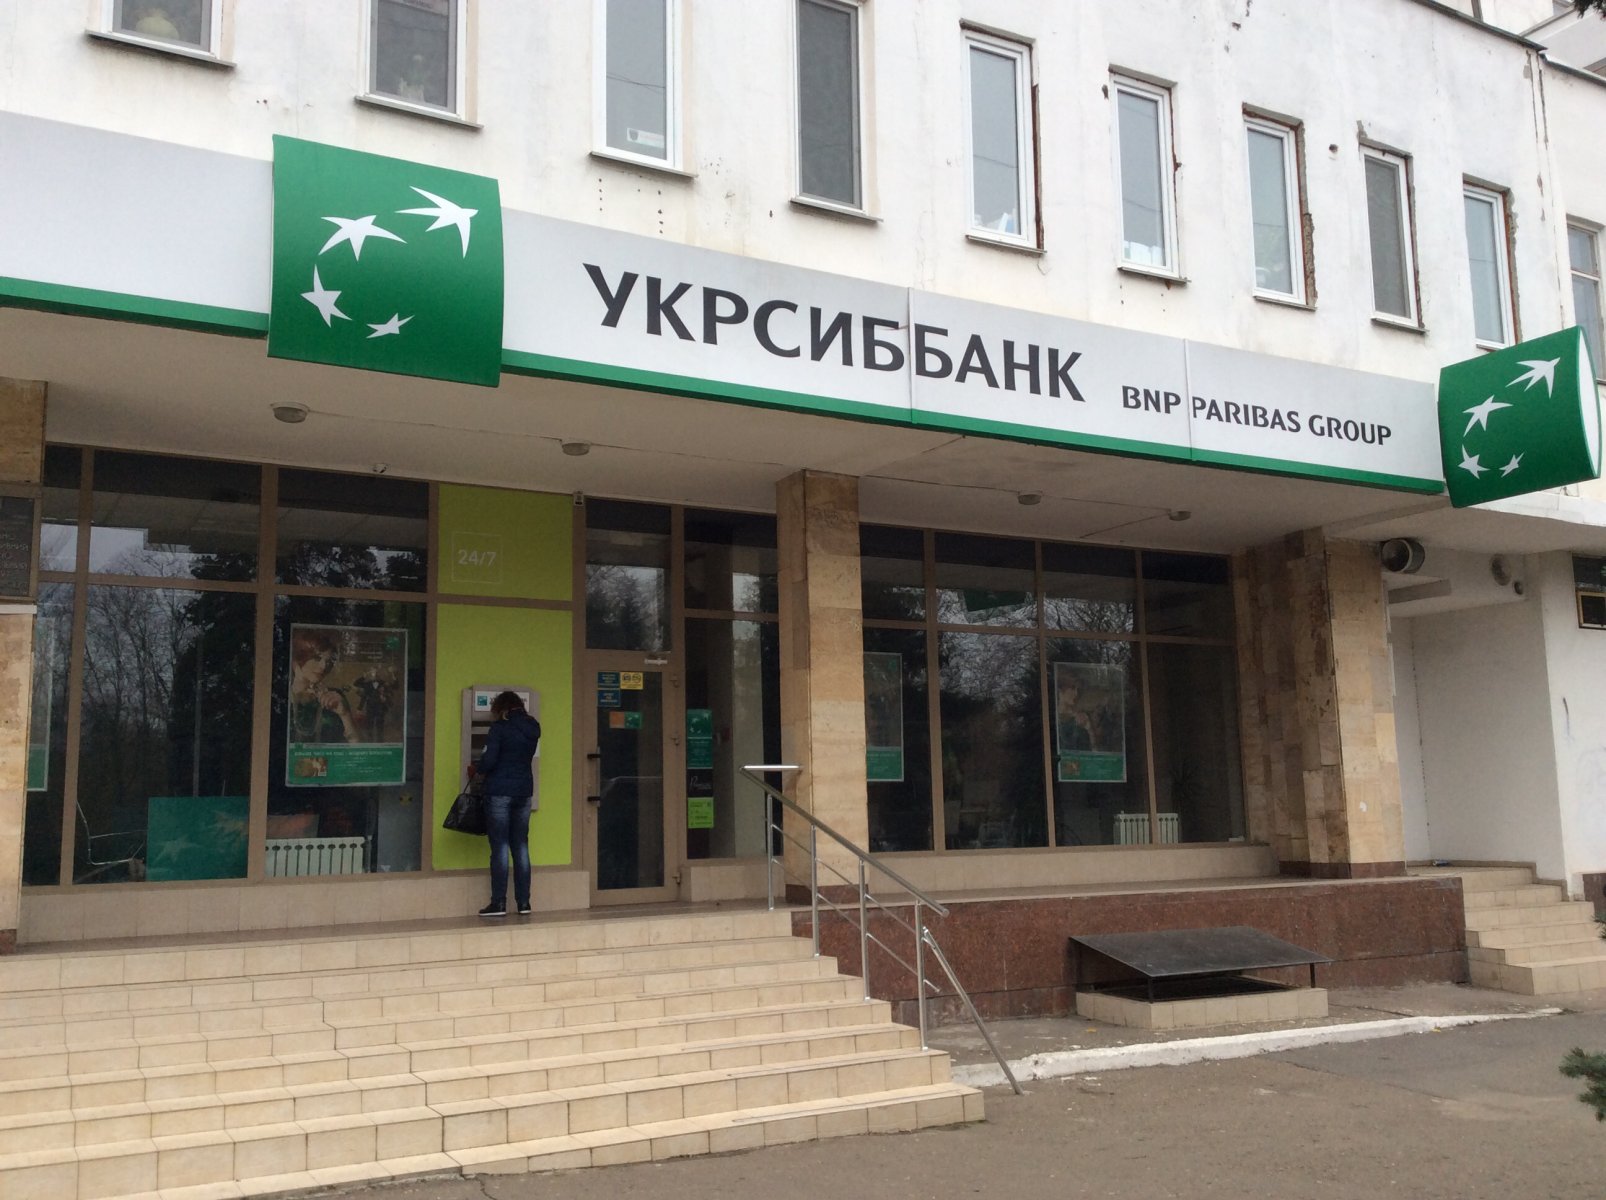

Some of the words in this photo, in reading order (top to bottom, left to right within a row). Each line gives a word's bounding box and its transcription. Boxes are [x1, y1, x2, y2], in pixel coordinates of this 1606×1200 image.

[582, 263, 1085, 402] УКРСИББАНК
[1122, 385, 1181, 414] BNP
[1192, 396, 1301, 433] PARIBAS
[1308, 415, 1392, 446] GROUP
[458, 549, 497, 567] 24/7
